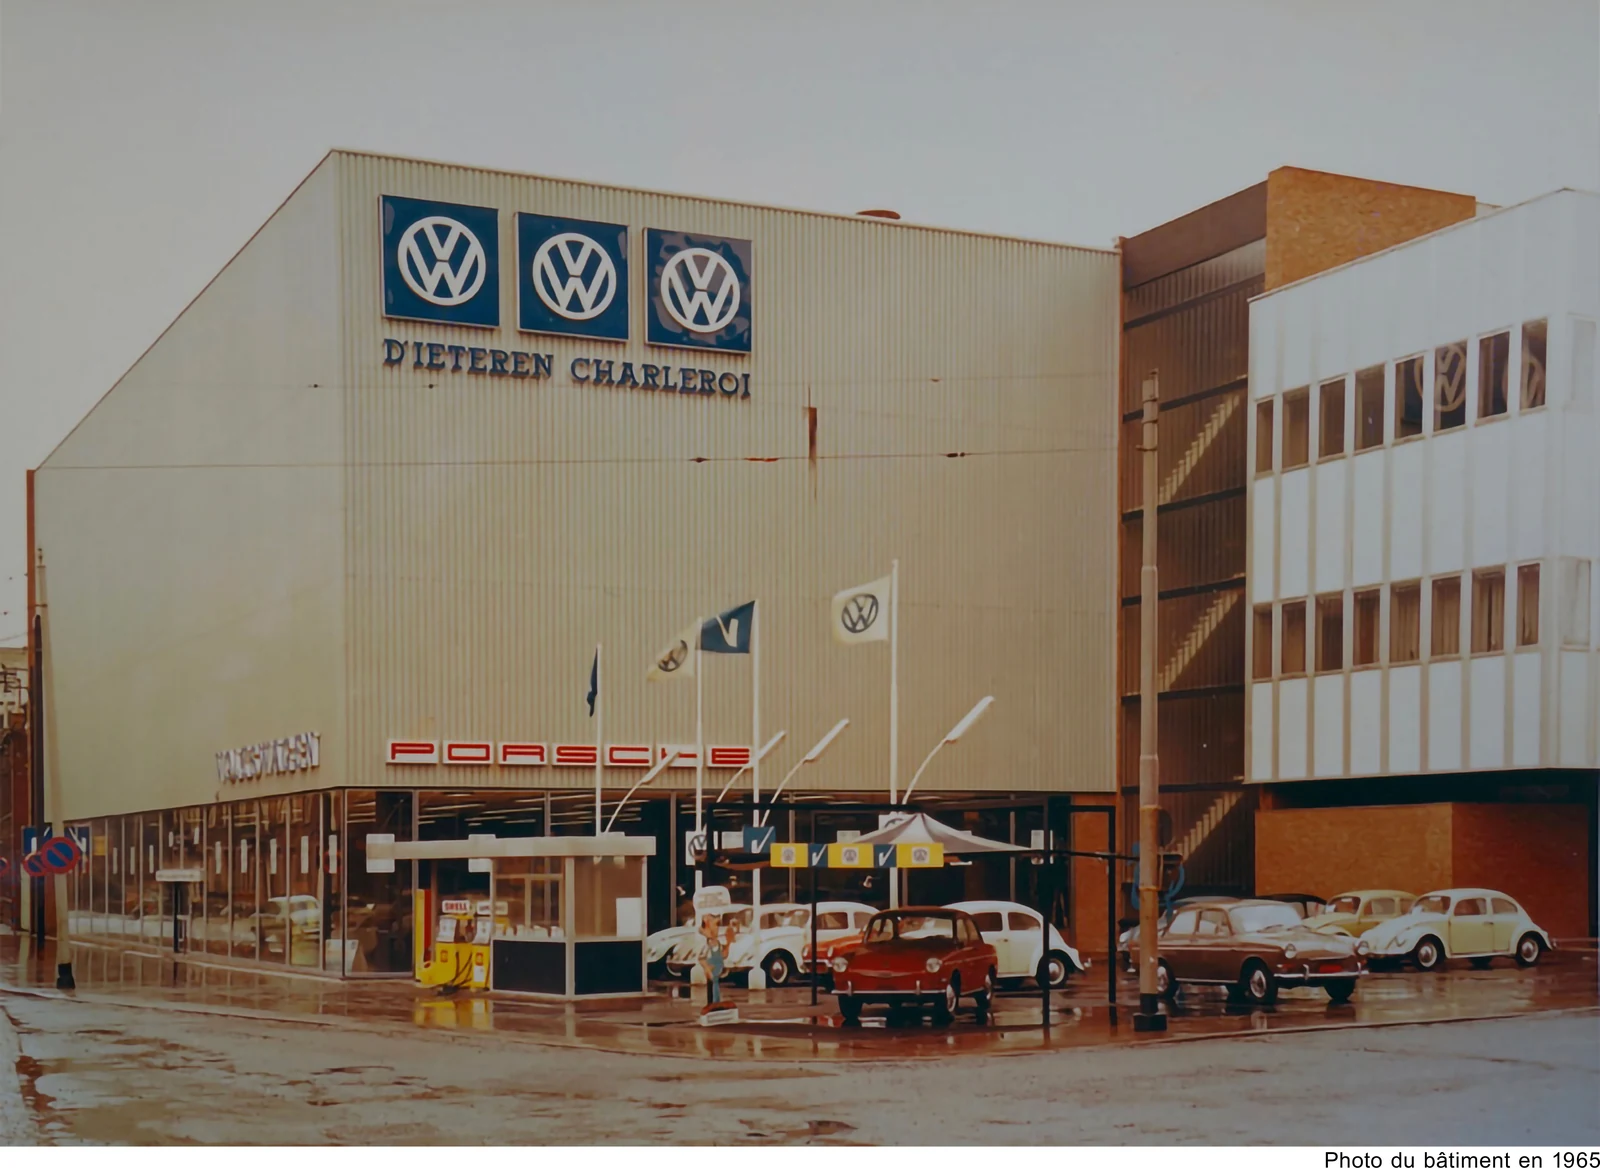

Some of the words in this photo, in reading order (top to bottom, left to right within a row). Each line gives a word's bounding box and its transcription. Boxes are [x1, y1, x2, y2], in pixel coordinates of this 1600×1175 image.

[398, 216, 486, 306] VW
[532, 232, 617, 320] VW
[661, 247, 741, 333] VW
[383, 338, 553, 377] D'IETEREN
[571, 357, 751, 399] CHARLEROI
